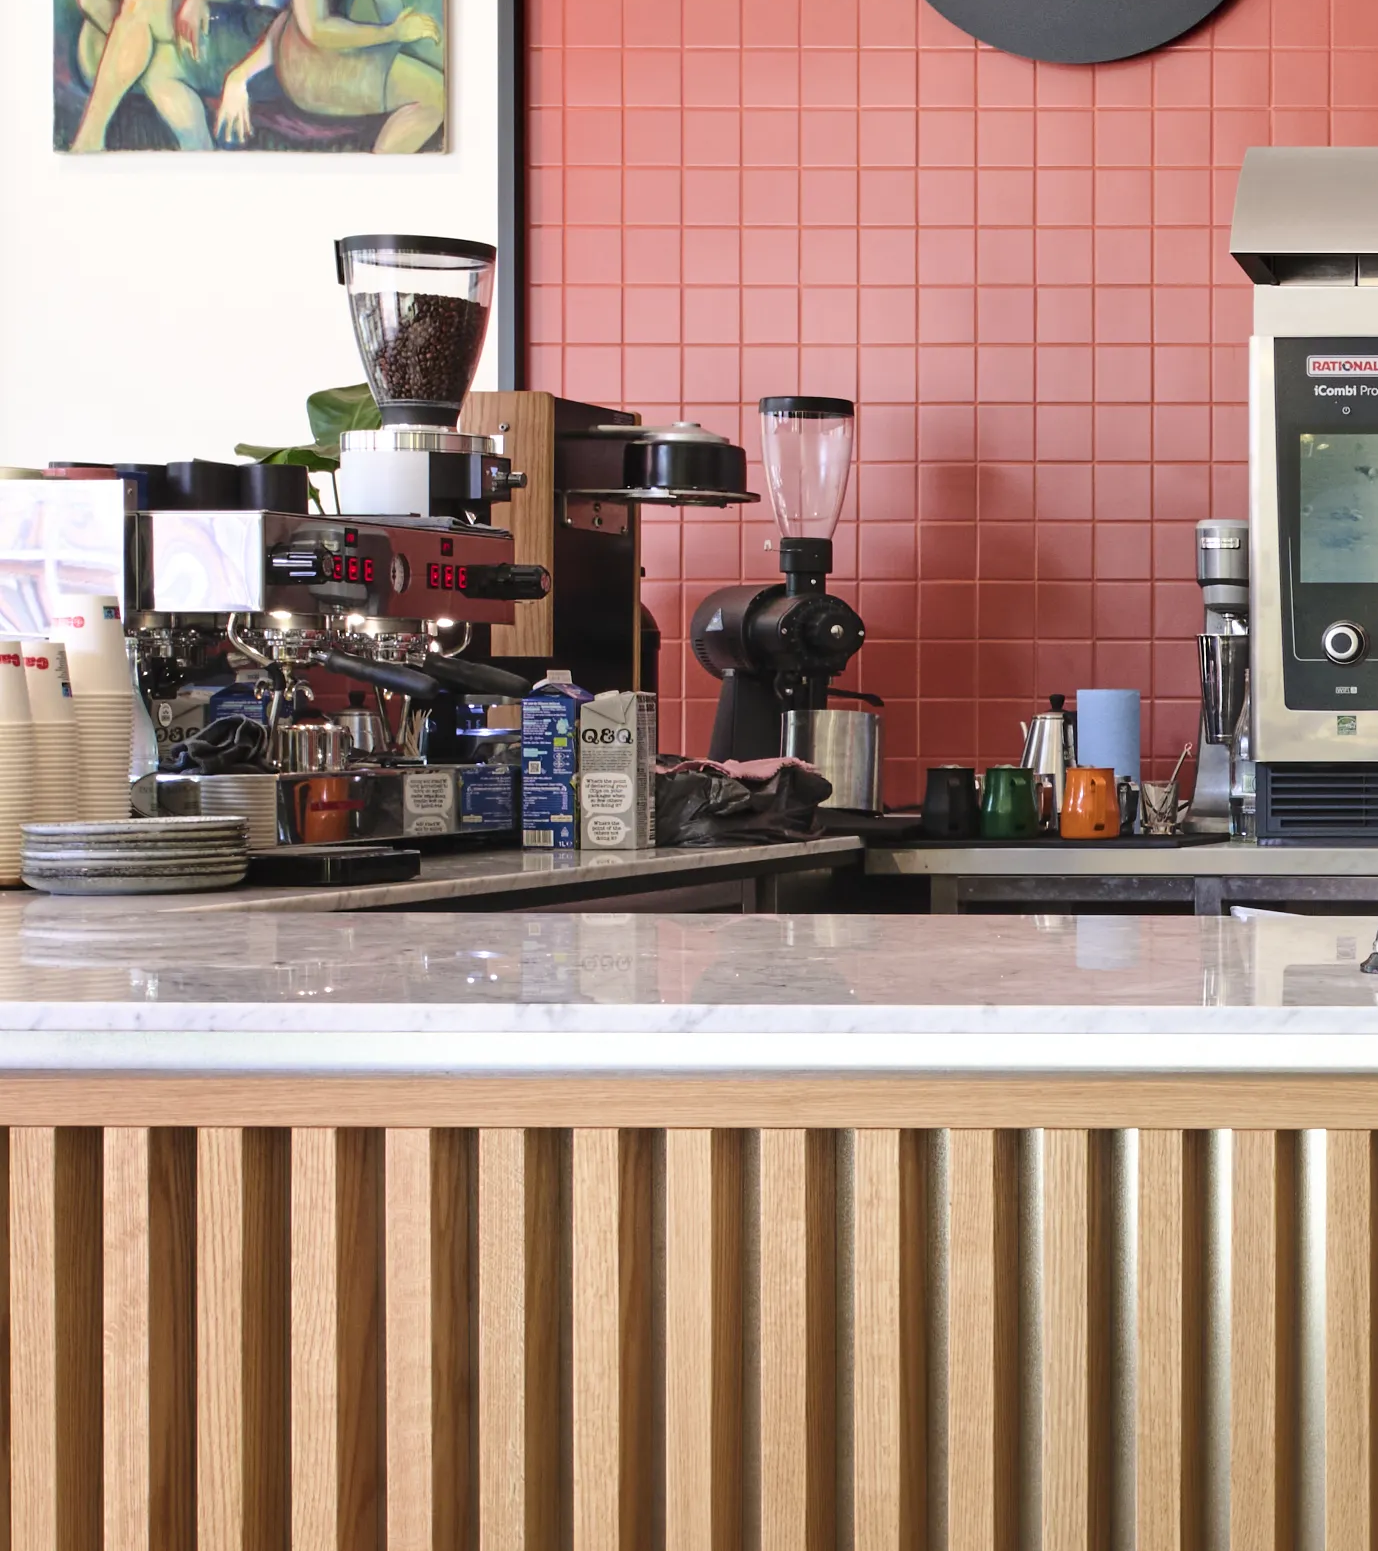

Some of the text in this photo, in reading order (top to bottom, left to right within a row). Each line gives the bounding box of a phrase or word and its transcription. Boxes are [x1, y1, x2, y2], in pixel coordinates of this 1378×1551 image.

[1314, 385, 1378, 396] iCombi Pro
[582, 728, 633, 745] Q&Q
